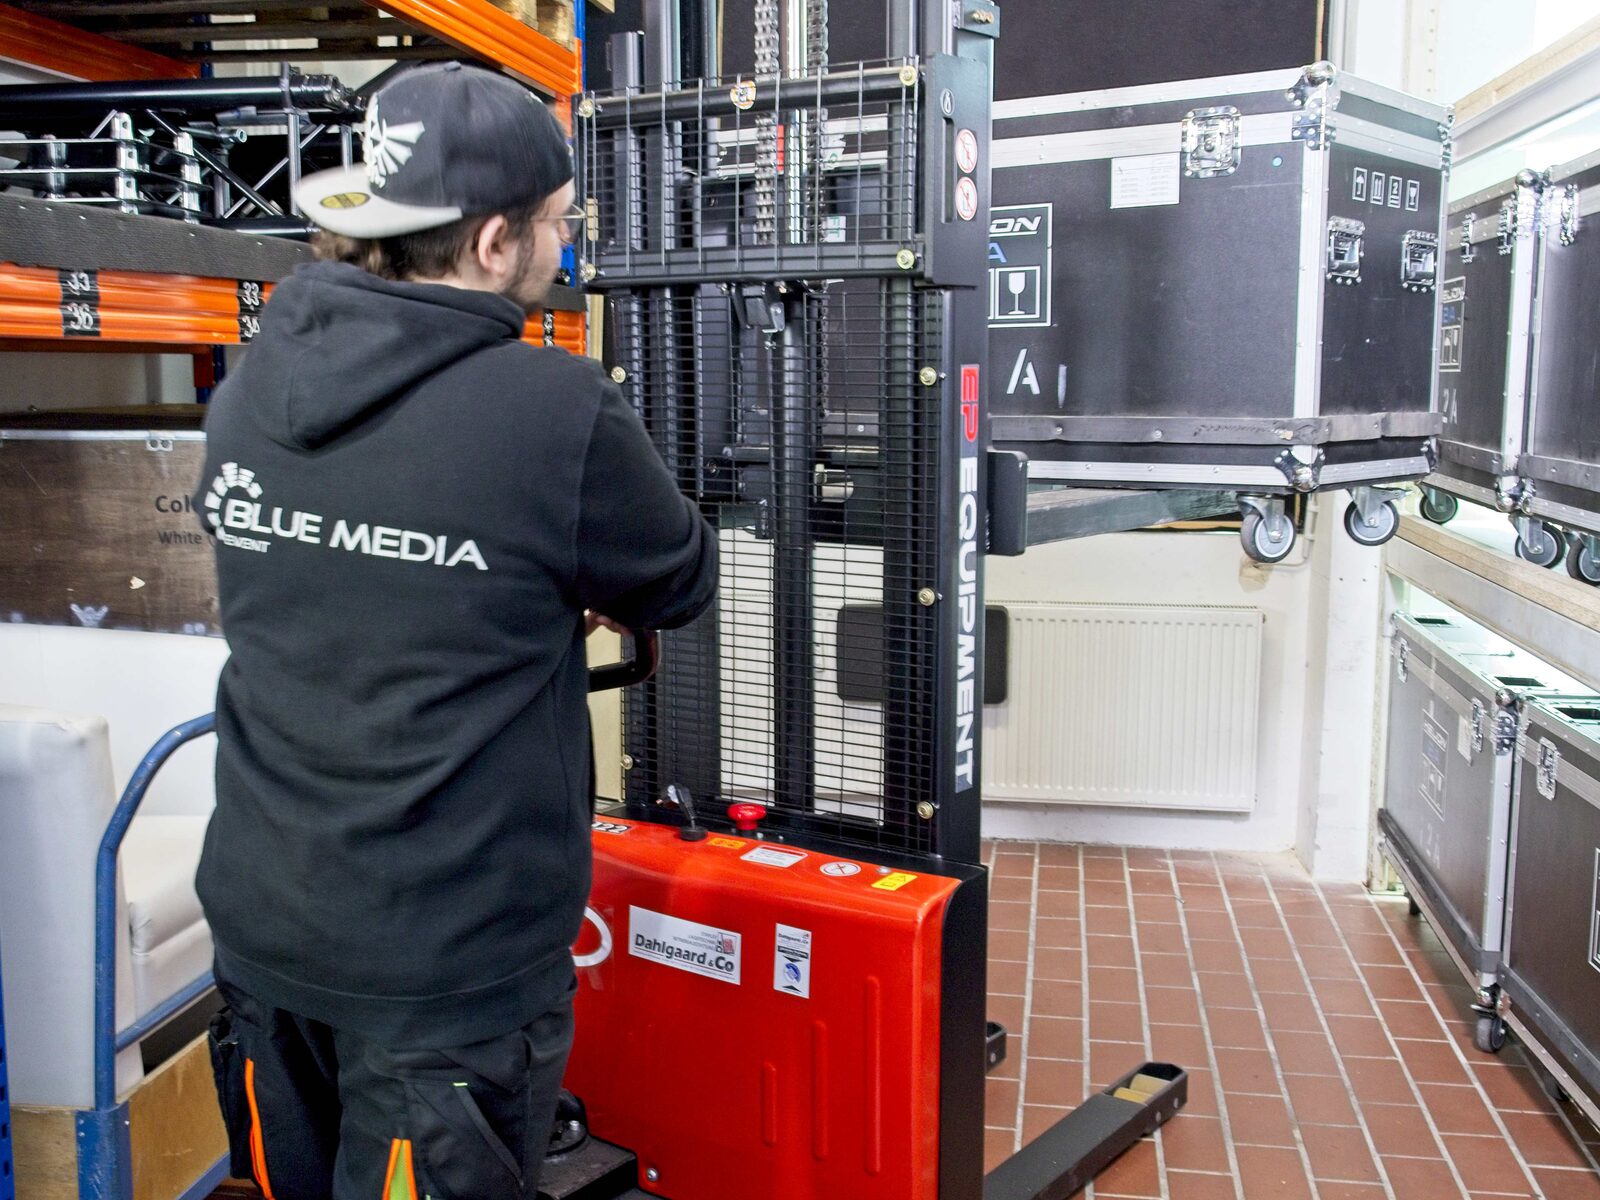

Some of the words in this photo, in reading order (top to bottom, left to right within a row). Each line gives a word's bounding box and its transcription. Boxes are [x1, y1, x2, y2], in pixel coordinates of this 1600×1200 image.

[989, 215, 1042, 232] ON
[988, 242, 1008, 263] A
[961, 365, 980, 443] EP
[155, 494, 191, 513] Col
[157, 530, 203, 545] White
[222, 533, 272, 554] EVENT
[223, 498, 324, 545] BLUE
[328, 519, 489, 571] MEDIA
[955, 456, 978, 786] EQUIPMENT
[634, 933, 707, 965] Dahlgaard
[714, 956, 736, 973] Co
